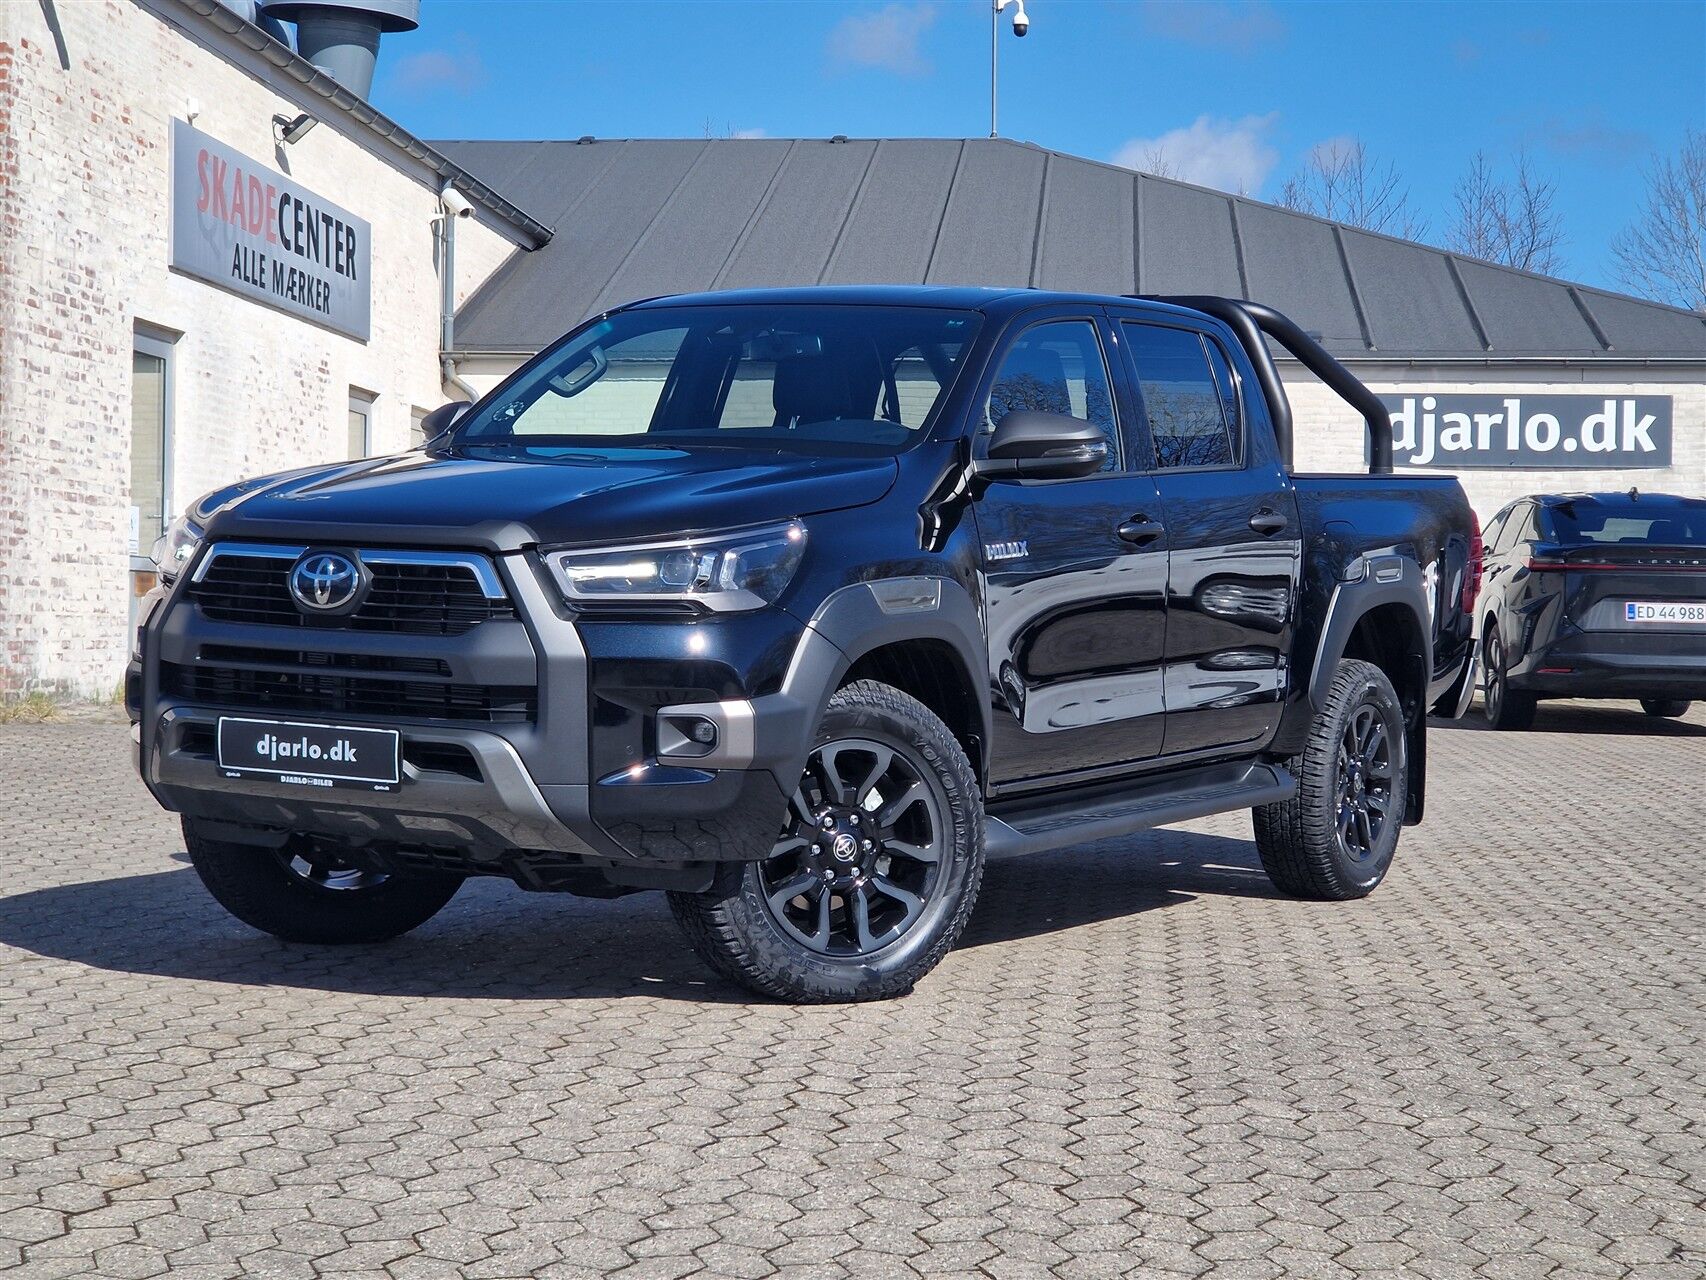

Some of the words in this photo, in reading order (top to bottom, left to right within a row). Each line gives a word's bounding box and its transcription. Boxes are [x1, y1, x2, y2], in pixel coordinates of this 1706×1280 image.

[197, 149, 357, 281] SKADECENTER
[231, 242, 266, 290] ALLE
[272, 259, 330, 315] MÆRKER
[1390, 396, 1657, 465] djarlo.dk
[1637, 606, 1656, 619] ED
[1659, 606, 1676, 620] 44
[1679, 606, 1705, 620] 988
[256, 733, 357, 762] djarlo.dk
